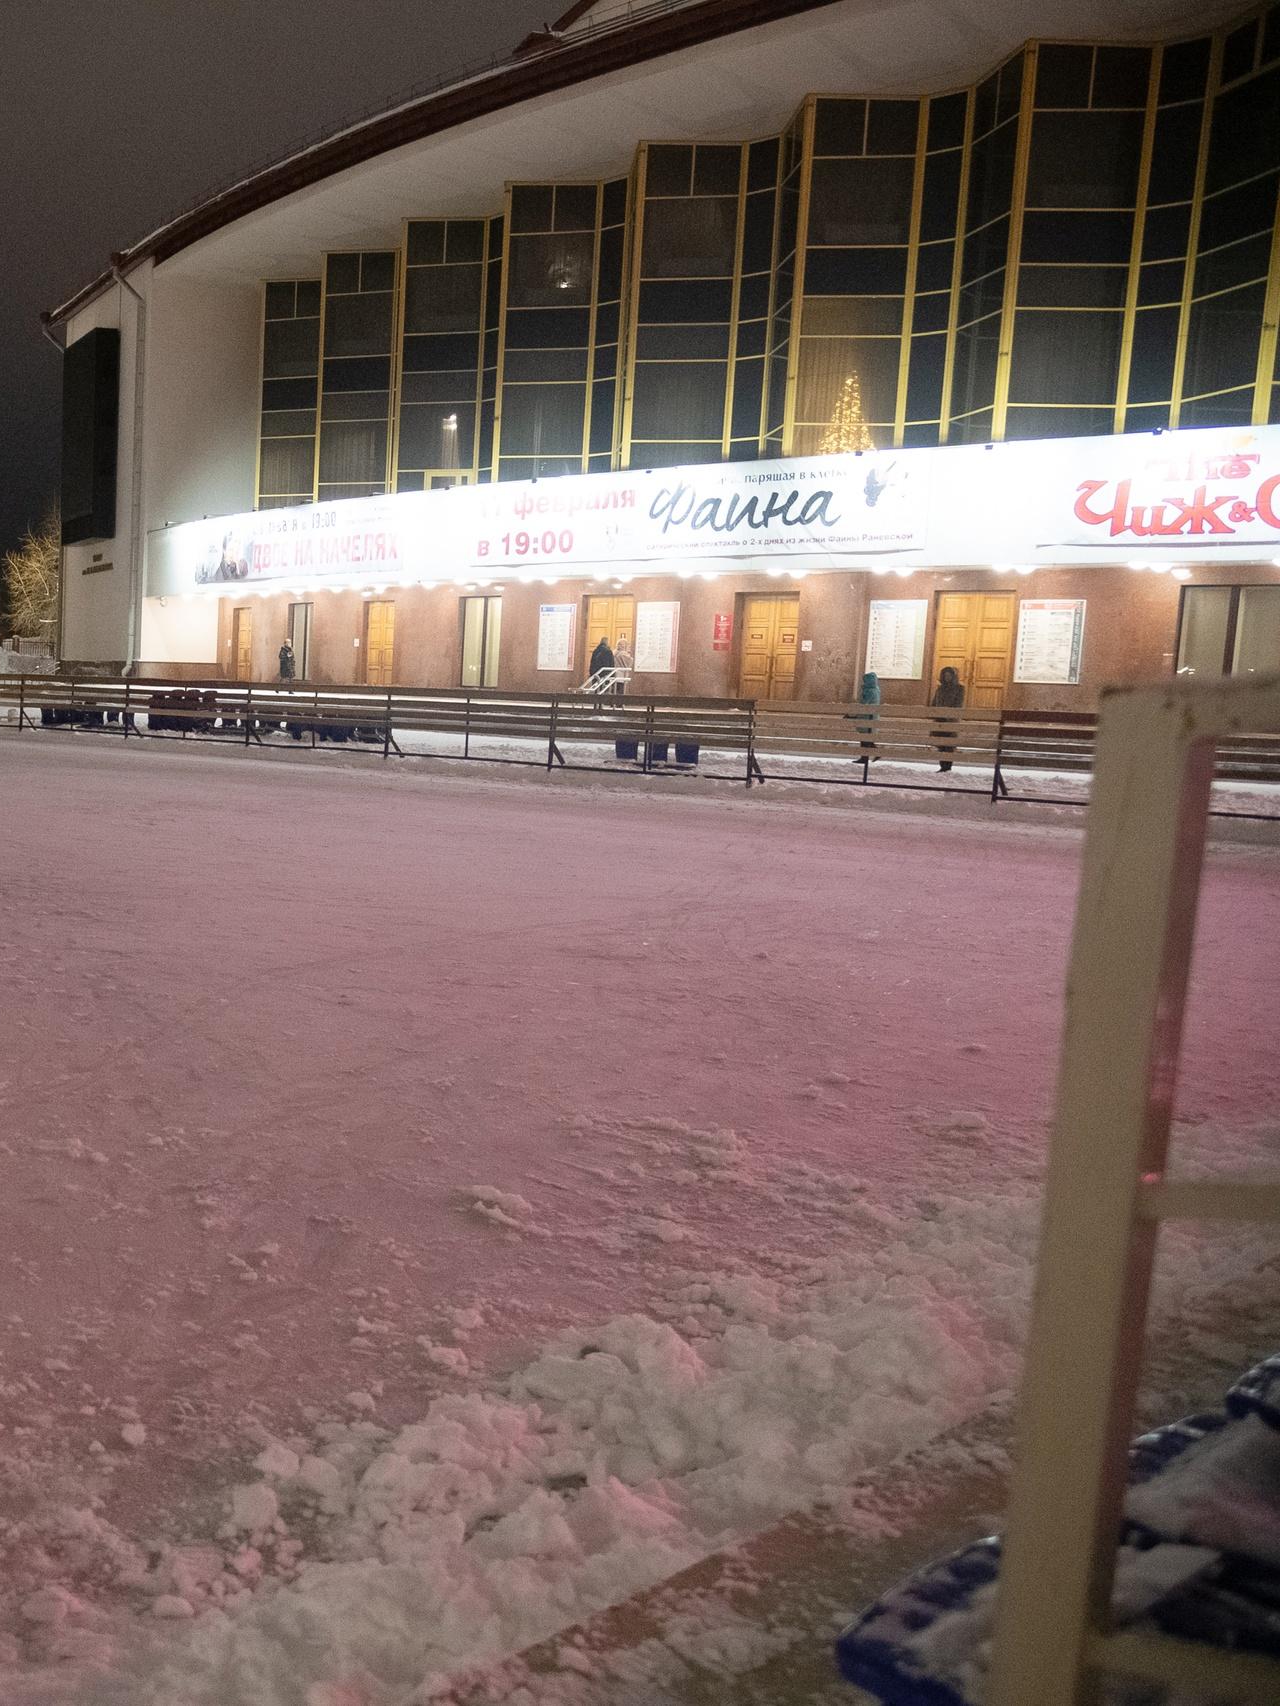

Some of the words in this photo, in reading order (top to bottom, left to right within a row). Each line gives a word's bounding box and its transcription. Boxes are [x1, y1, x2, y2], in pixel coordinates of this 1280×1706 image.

[513, 489, 637, 520] февраля
[648, 480, 841, 534] Фаина
[501, 530, 574, 556] 19:00
